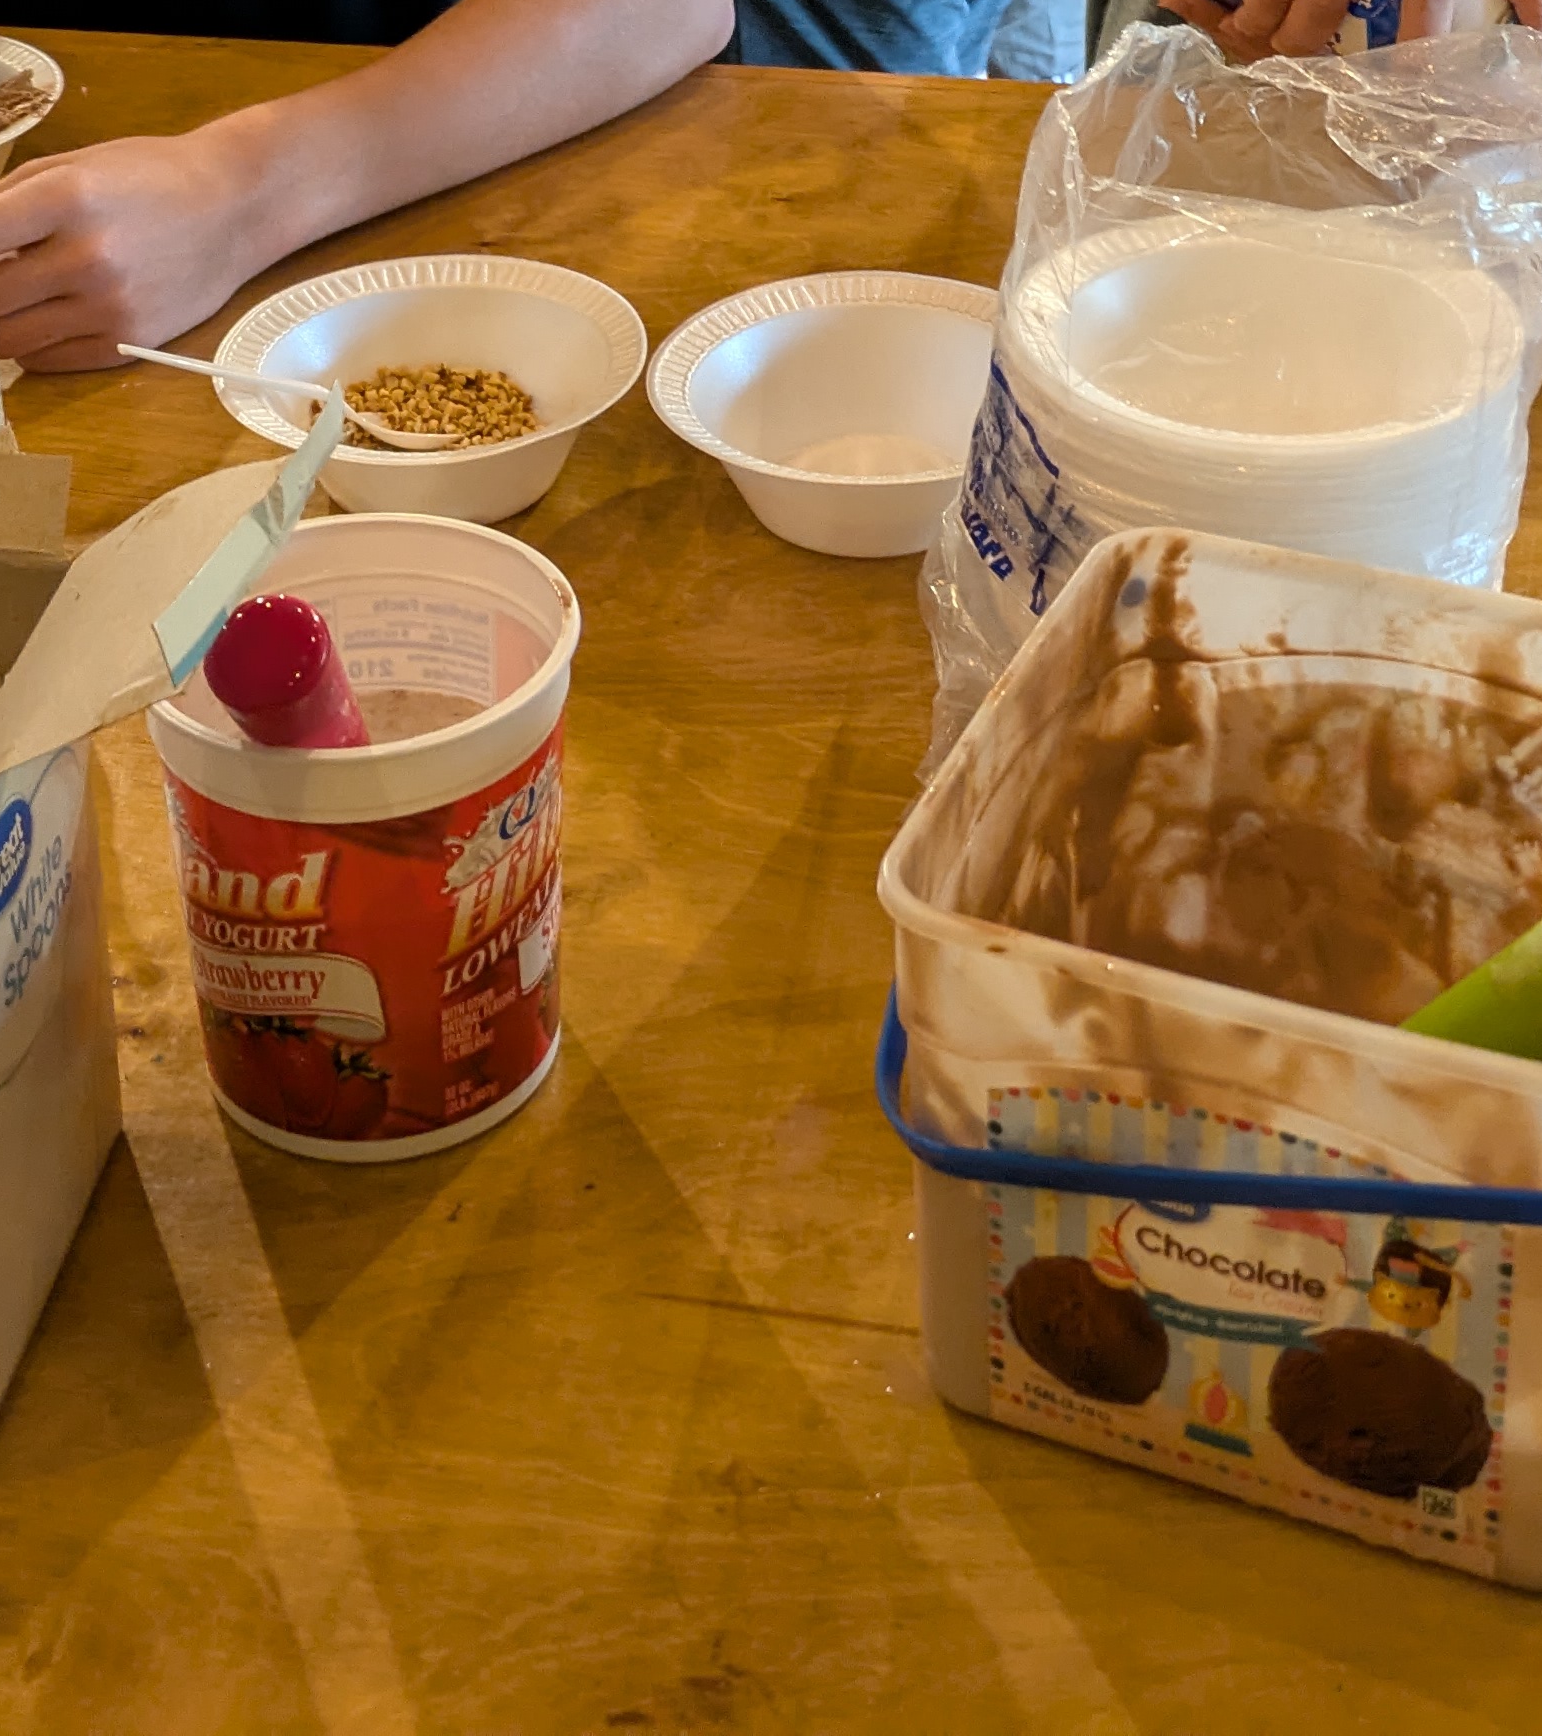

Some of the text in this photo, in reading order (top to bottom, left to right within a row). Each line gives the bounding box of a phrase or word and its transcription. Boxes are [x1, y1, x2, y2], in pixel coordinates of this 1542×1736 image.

[10, 835, 63, 943] White
[202, 914, 327, 952] YOGURT
[1134, 1226, 1326, 1299] Chocolate
